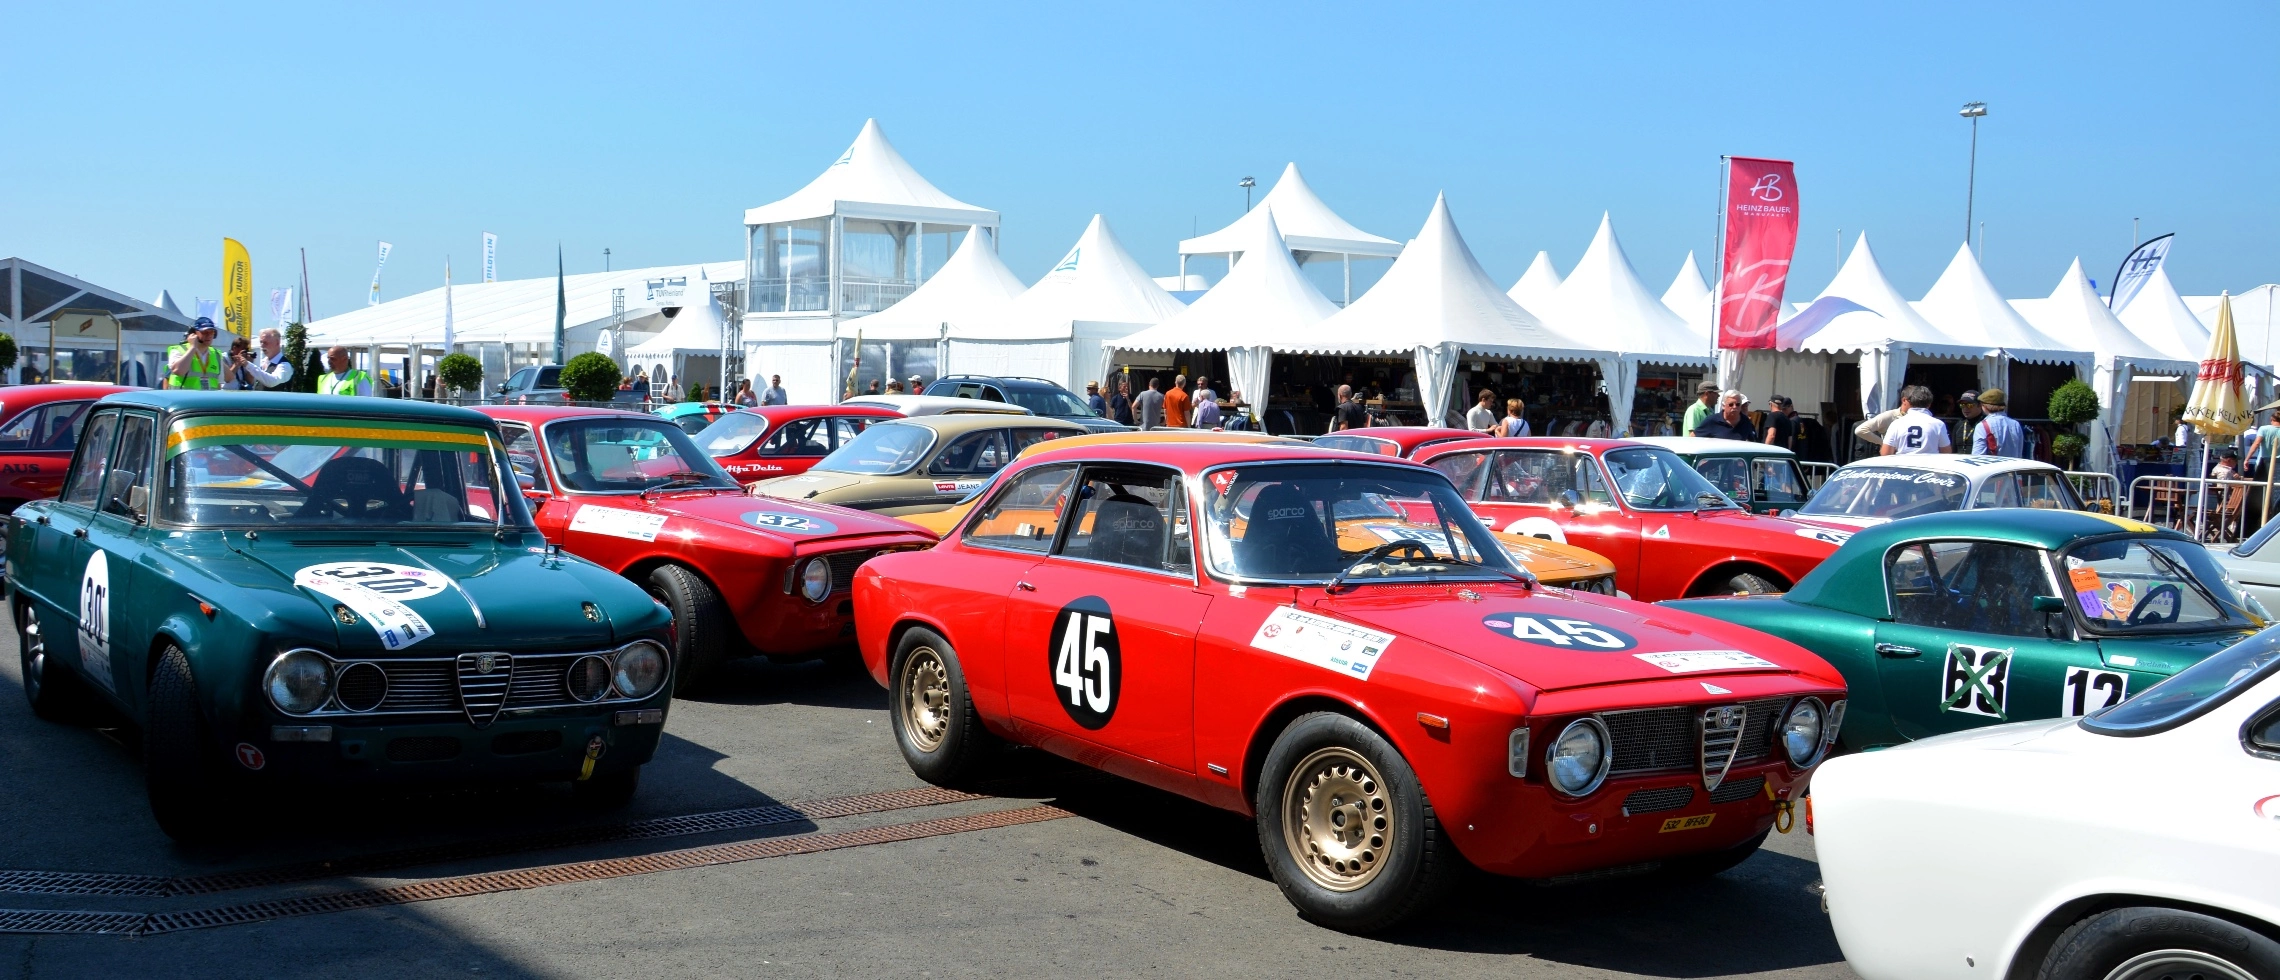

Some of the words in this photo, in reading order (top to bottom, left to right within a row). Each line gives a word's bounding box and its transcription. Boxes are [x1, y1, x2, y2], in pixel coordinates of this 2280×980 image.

[236, 261, 244, 293] JUNIOR
[1907, 425, 1923, 448] 2
[724, 464, 750, 474] Alfa
[746, 464, 784, 472] Delta
[759, 514, 810, 531] 32
[1112, 518, 1155, 532] sparco
[1267, 507, 1305, 520] sparco
[1513, 616, 1626, 648] 45
[1055, 611, 1111, 714] 45
[1945, 646, 2008, 715] 63
[2067, 669, 2124, 717] 12
